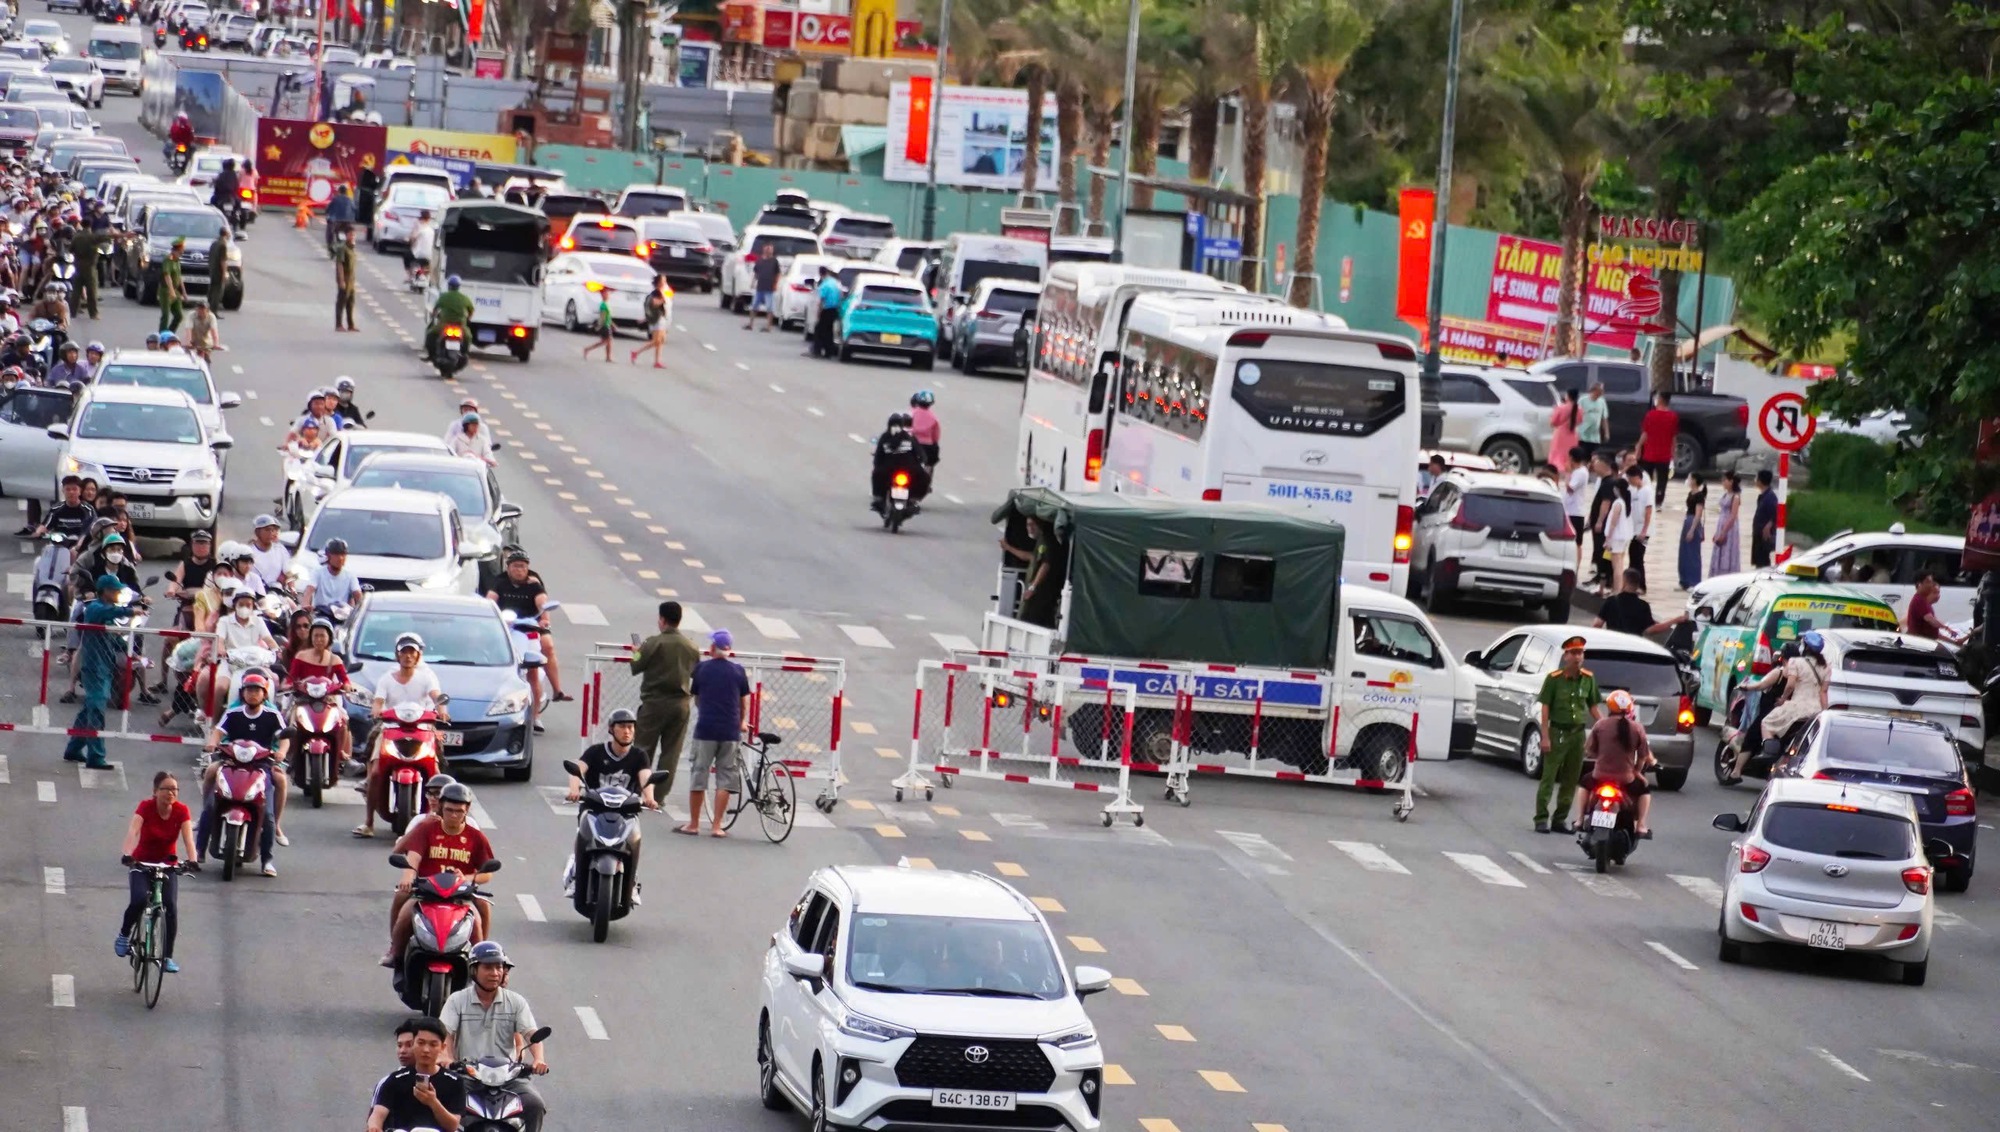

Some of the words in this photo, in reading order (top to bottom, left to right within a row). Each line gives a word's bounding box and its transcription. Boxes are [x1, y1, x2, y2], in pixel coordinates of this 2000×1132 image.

[431, 146, 493, 160] DICERA
[1599, 215, 1698, 243] MASSAGE
[1587, 244, 1625, 265] CAO
[1269, 415, 1365, 432] UNIVERSE
[1267, 483, 1353, 504] 50H-855.62
[1808, 601, 1847, 611] MPE
[1145, 674, 1206, 697] CẢH
[1214, 680, 1258, 699] SÁT
[1363, 690, 1397, 704] CÔNG
[1819, 923, 1838, 935] 47A
[1810, 934, 1844, 949] 094.26
